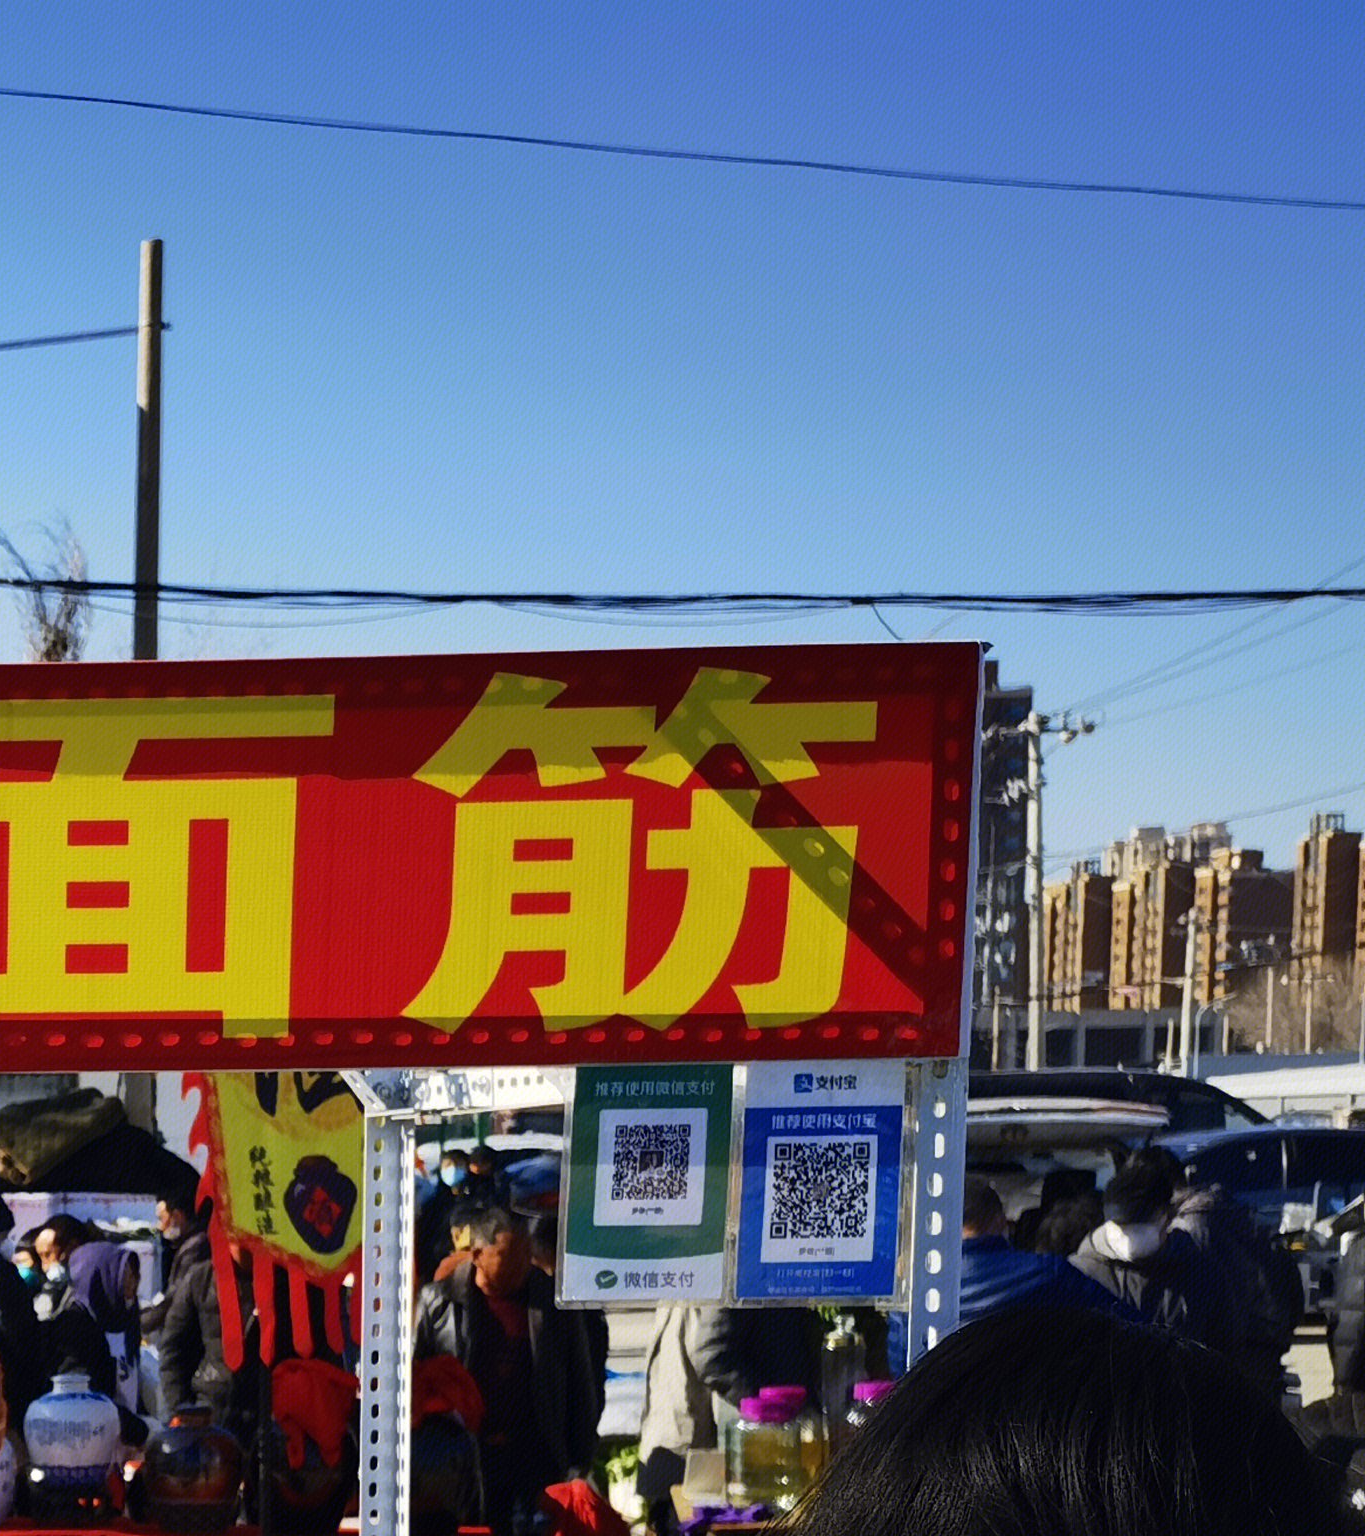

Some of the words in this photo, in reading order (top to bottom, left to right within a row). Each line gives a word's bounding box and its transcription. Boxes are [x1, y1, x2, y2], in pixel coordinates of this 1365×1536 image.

[594, 1080, 717, 1098] 推荐使用微信支付
[815, 1074, 858, 1091] 支付宝
[770, 1112, 878, 1131] 推荐使用支付宝
[623, 1270, 696, 1289] 微信支付
